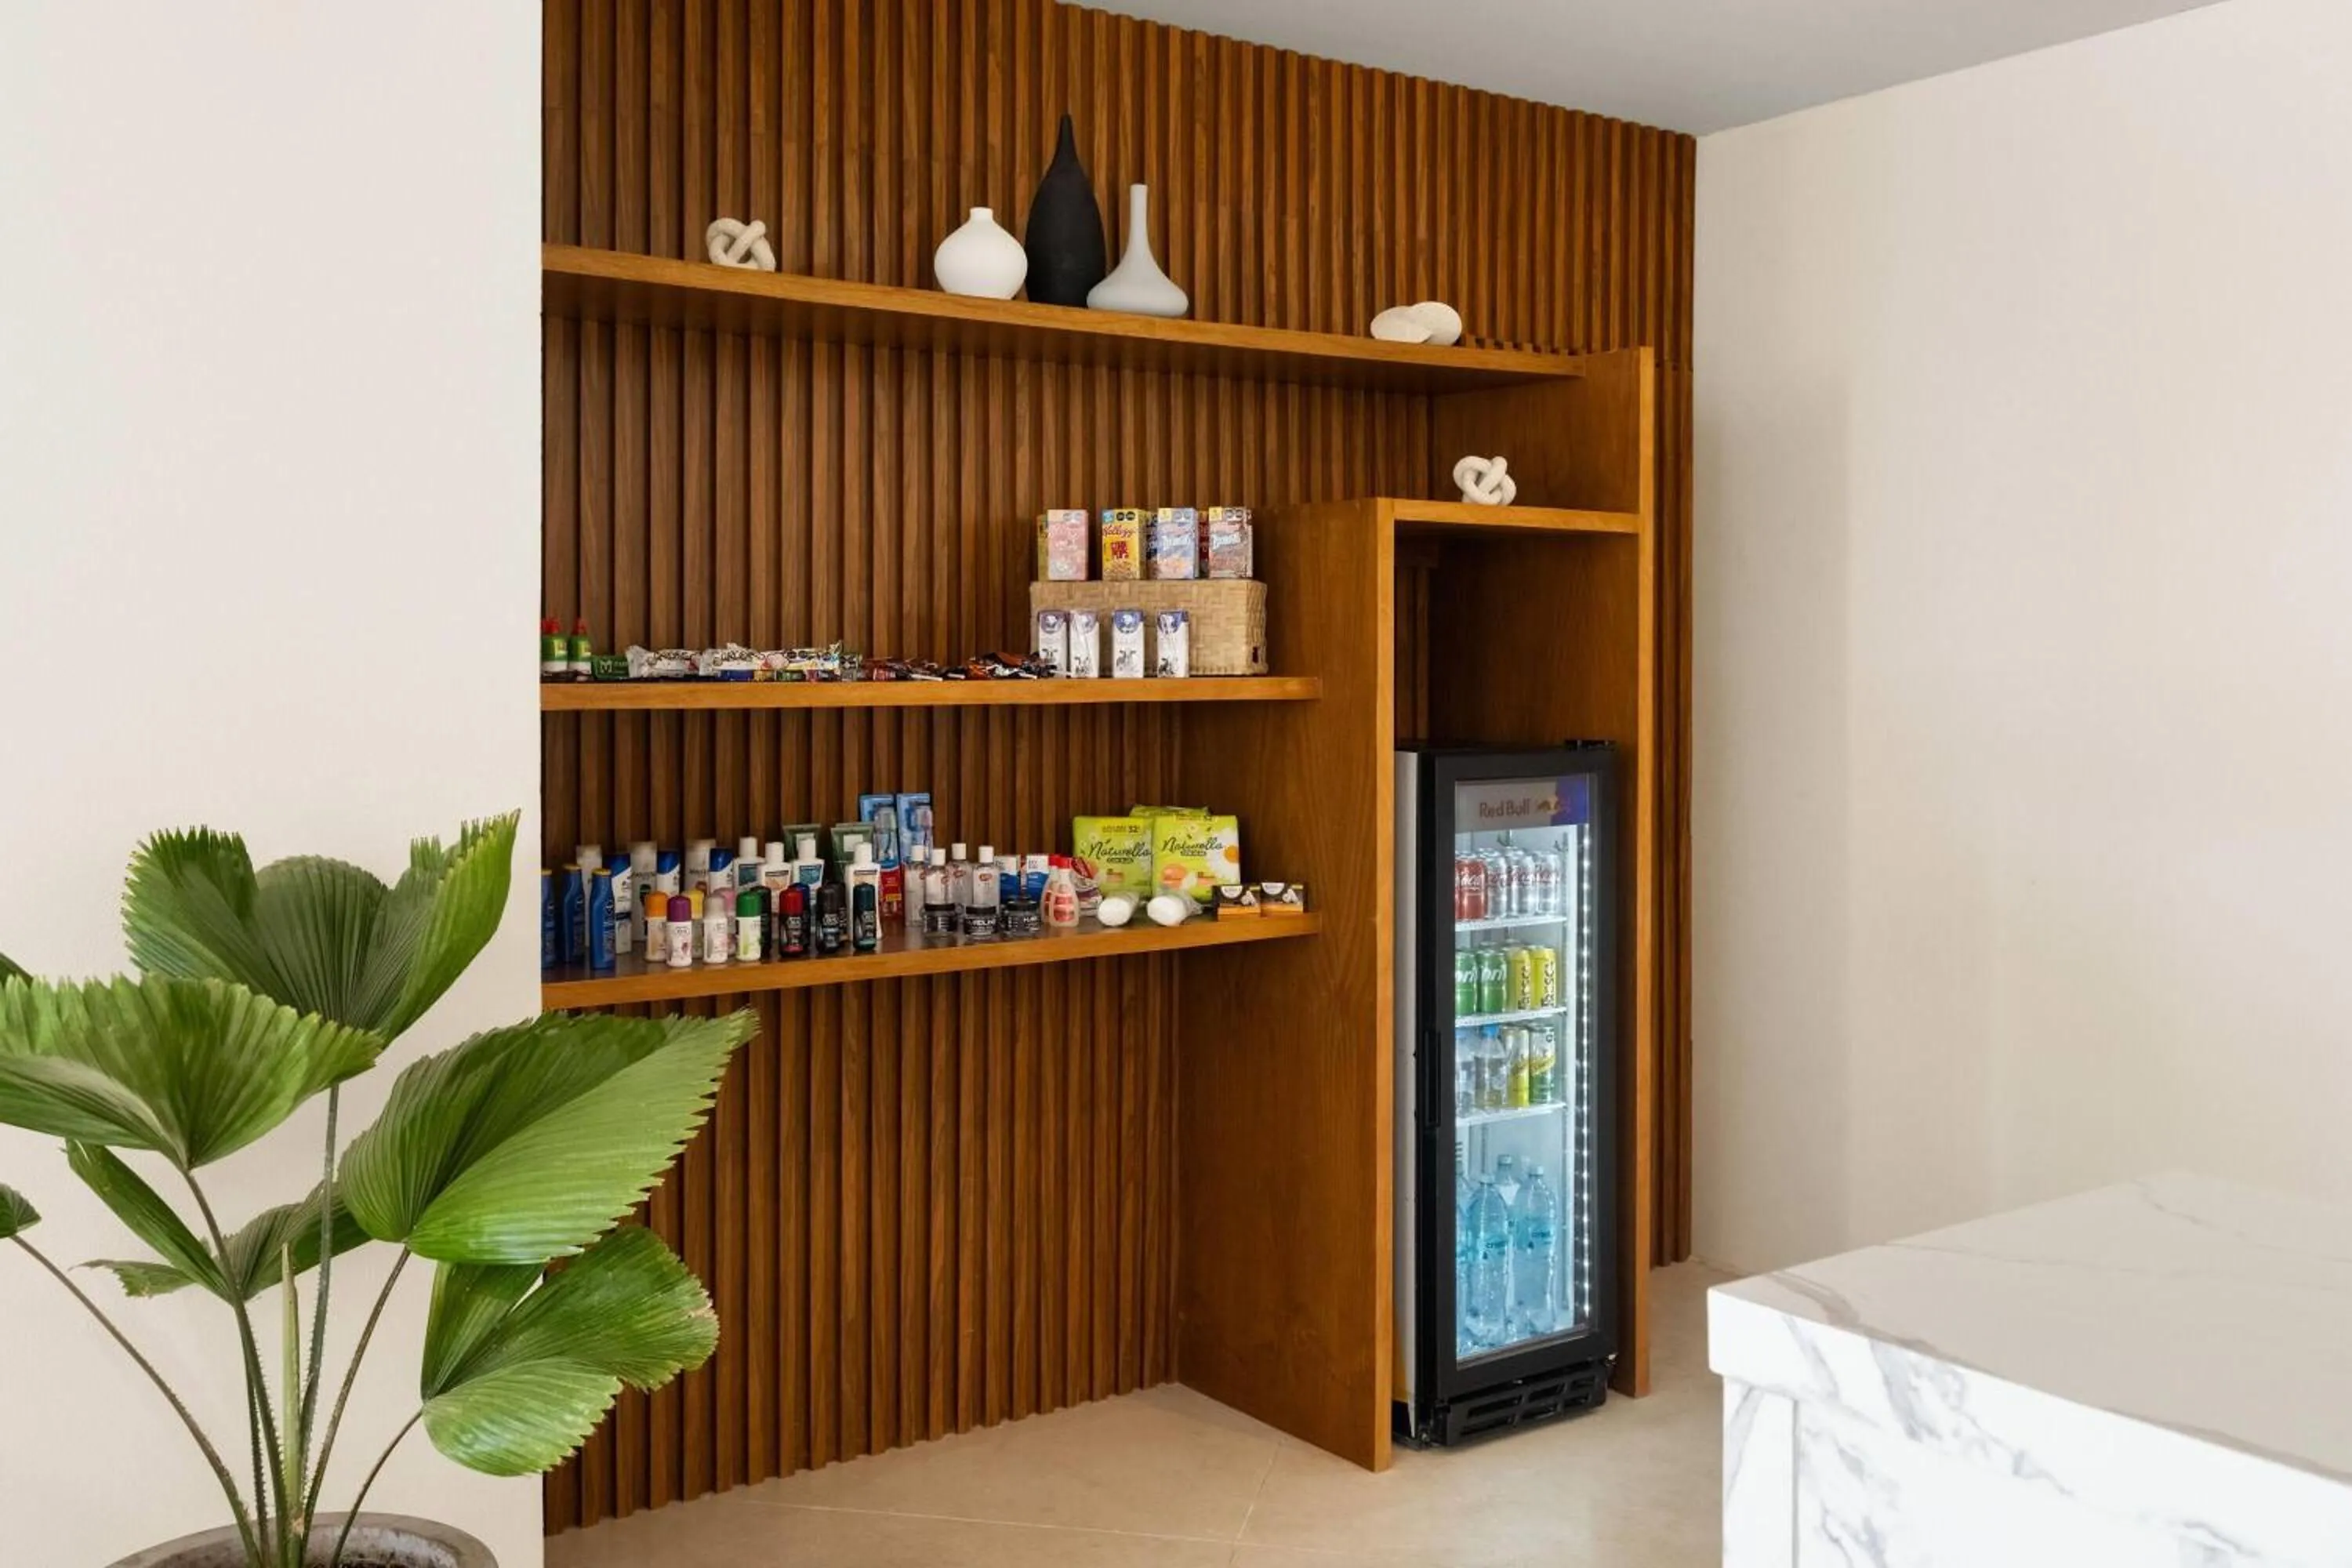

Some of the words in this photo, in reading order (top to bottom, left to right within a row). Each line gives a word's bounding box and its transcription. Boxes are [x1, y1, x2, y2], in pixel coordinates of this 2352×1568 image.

[1479, 801, 1504, 818] Red
[1506, 798, 1530, 816] Bull
[1088, 840, 1152, 861] Naturella
[1162, 837, 1223, 854] Naturella
